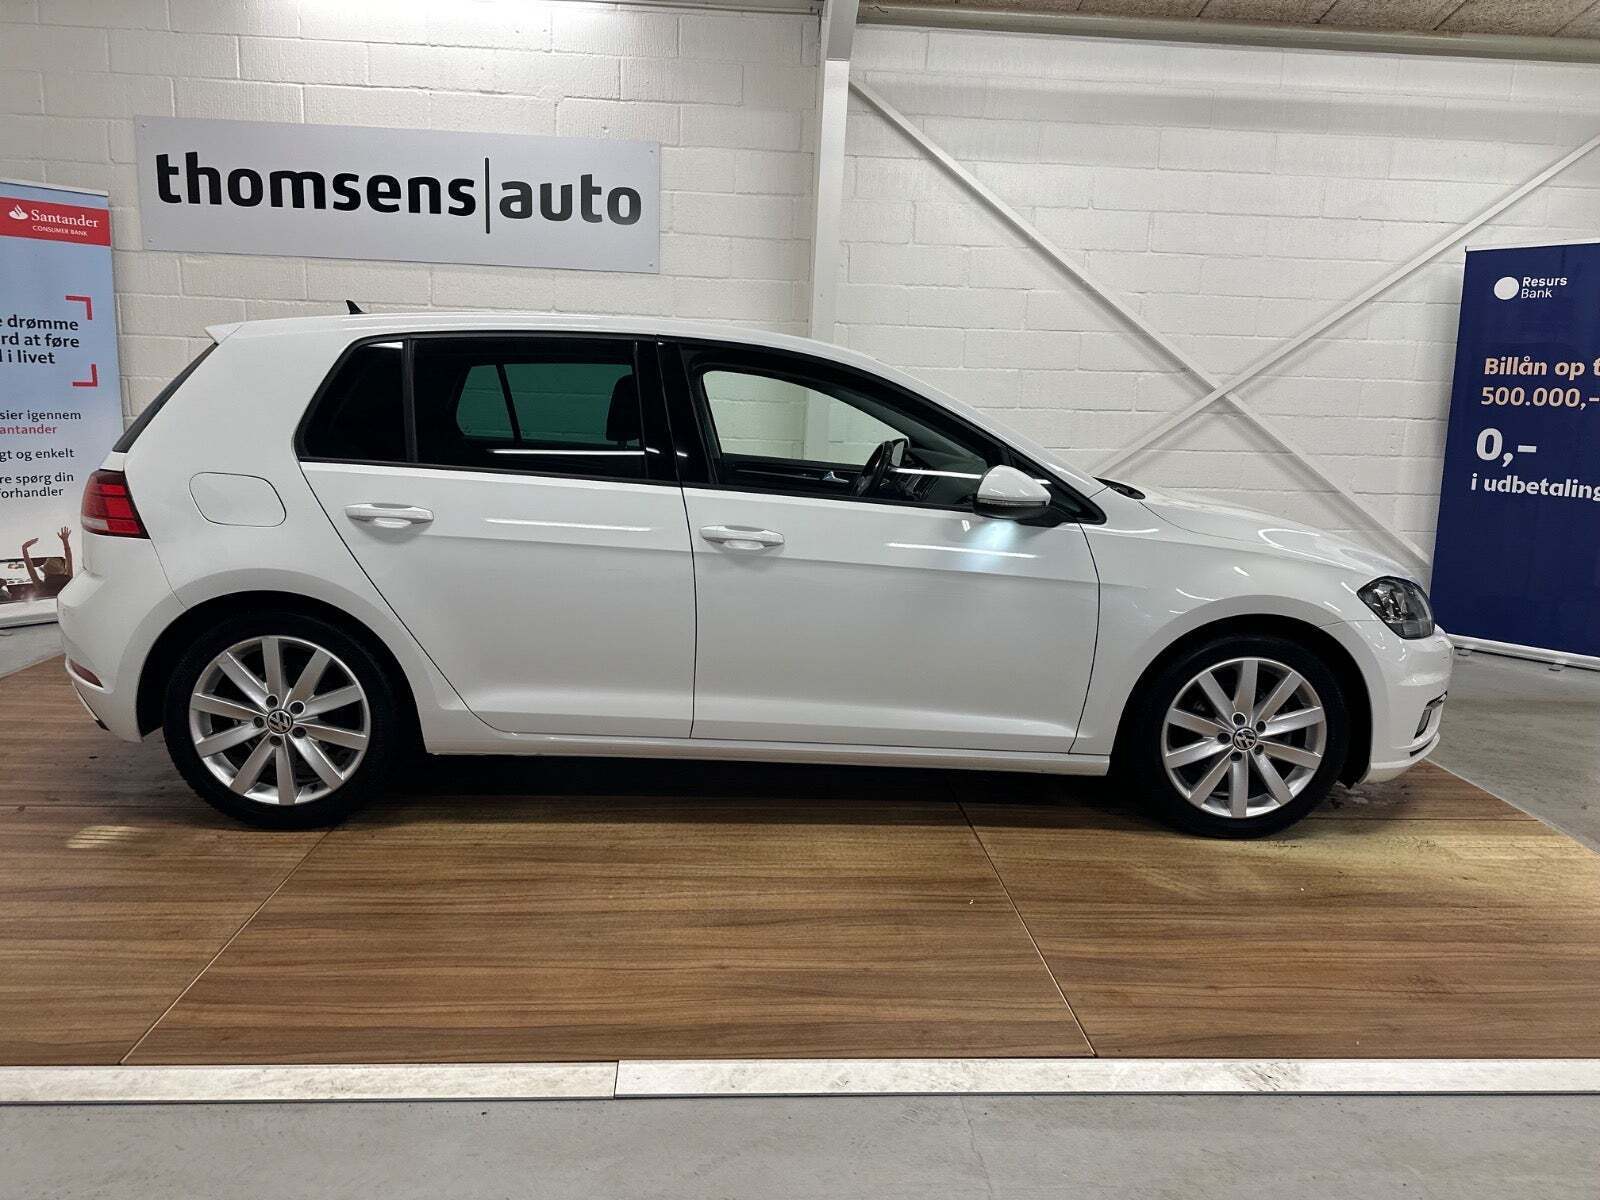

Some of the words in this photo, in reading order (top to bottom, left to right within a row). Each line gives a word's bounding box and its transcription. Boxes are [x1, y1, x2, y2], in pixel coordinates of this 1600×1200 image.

[156, 152, 476, 217] thomsens
[499, 173, 643, 226] auto
[31, 209, 99, 228] Santander
[32, 225, 69, 234] CONSUMER
[70, 229, 88, 237] BANK
[1522, 276, 1568, 287] Resurs
[1520, 288, 1553, 299] Bank
[7, 314, 79, 330] drømme
[23, 334, 41, 346] at
[44, 333, 80, 348] føre
[8, 349, 12, 363] i
[17, 350, 56, 364] livet
[1484, 355, 1548, 376] Billån
[1554, 361, 1586, 381] op
[27, 410, 82, 422] igennem
[0, 424, 57, 435] antander
[16, 451, 32, 462] og
[35, 448, 75, 459] enkelt
[15, 474, 52, 486] spørg
[54, 472, 74, 482] din
[1470, 473, 1478, 491] i
[0, 486, 64, 498] orhandler
